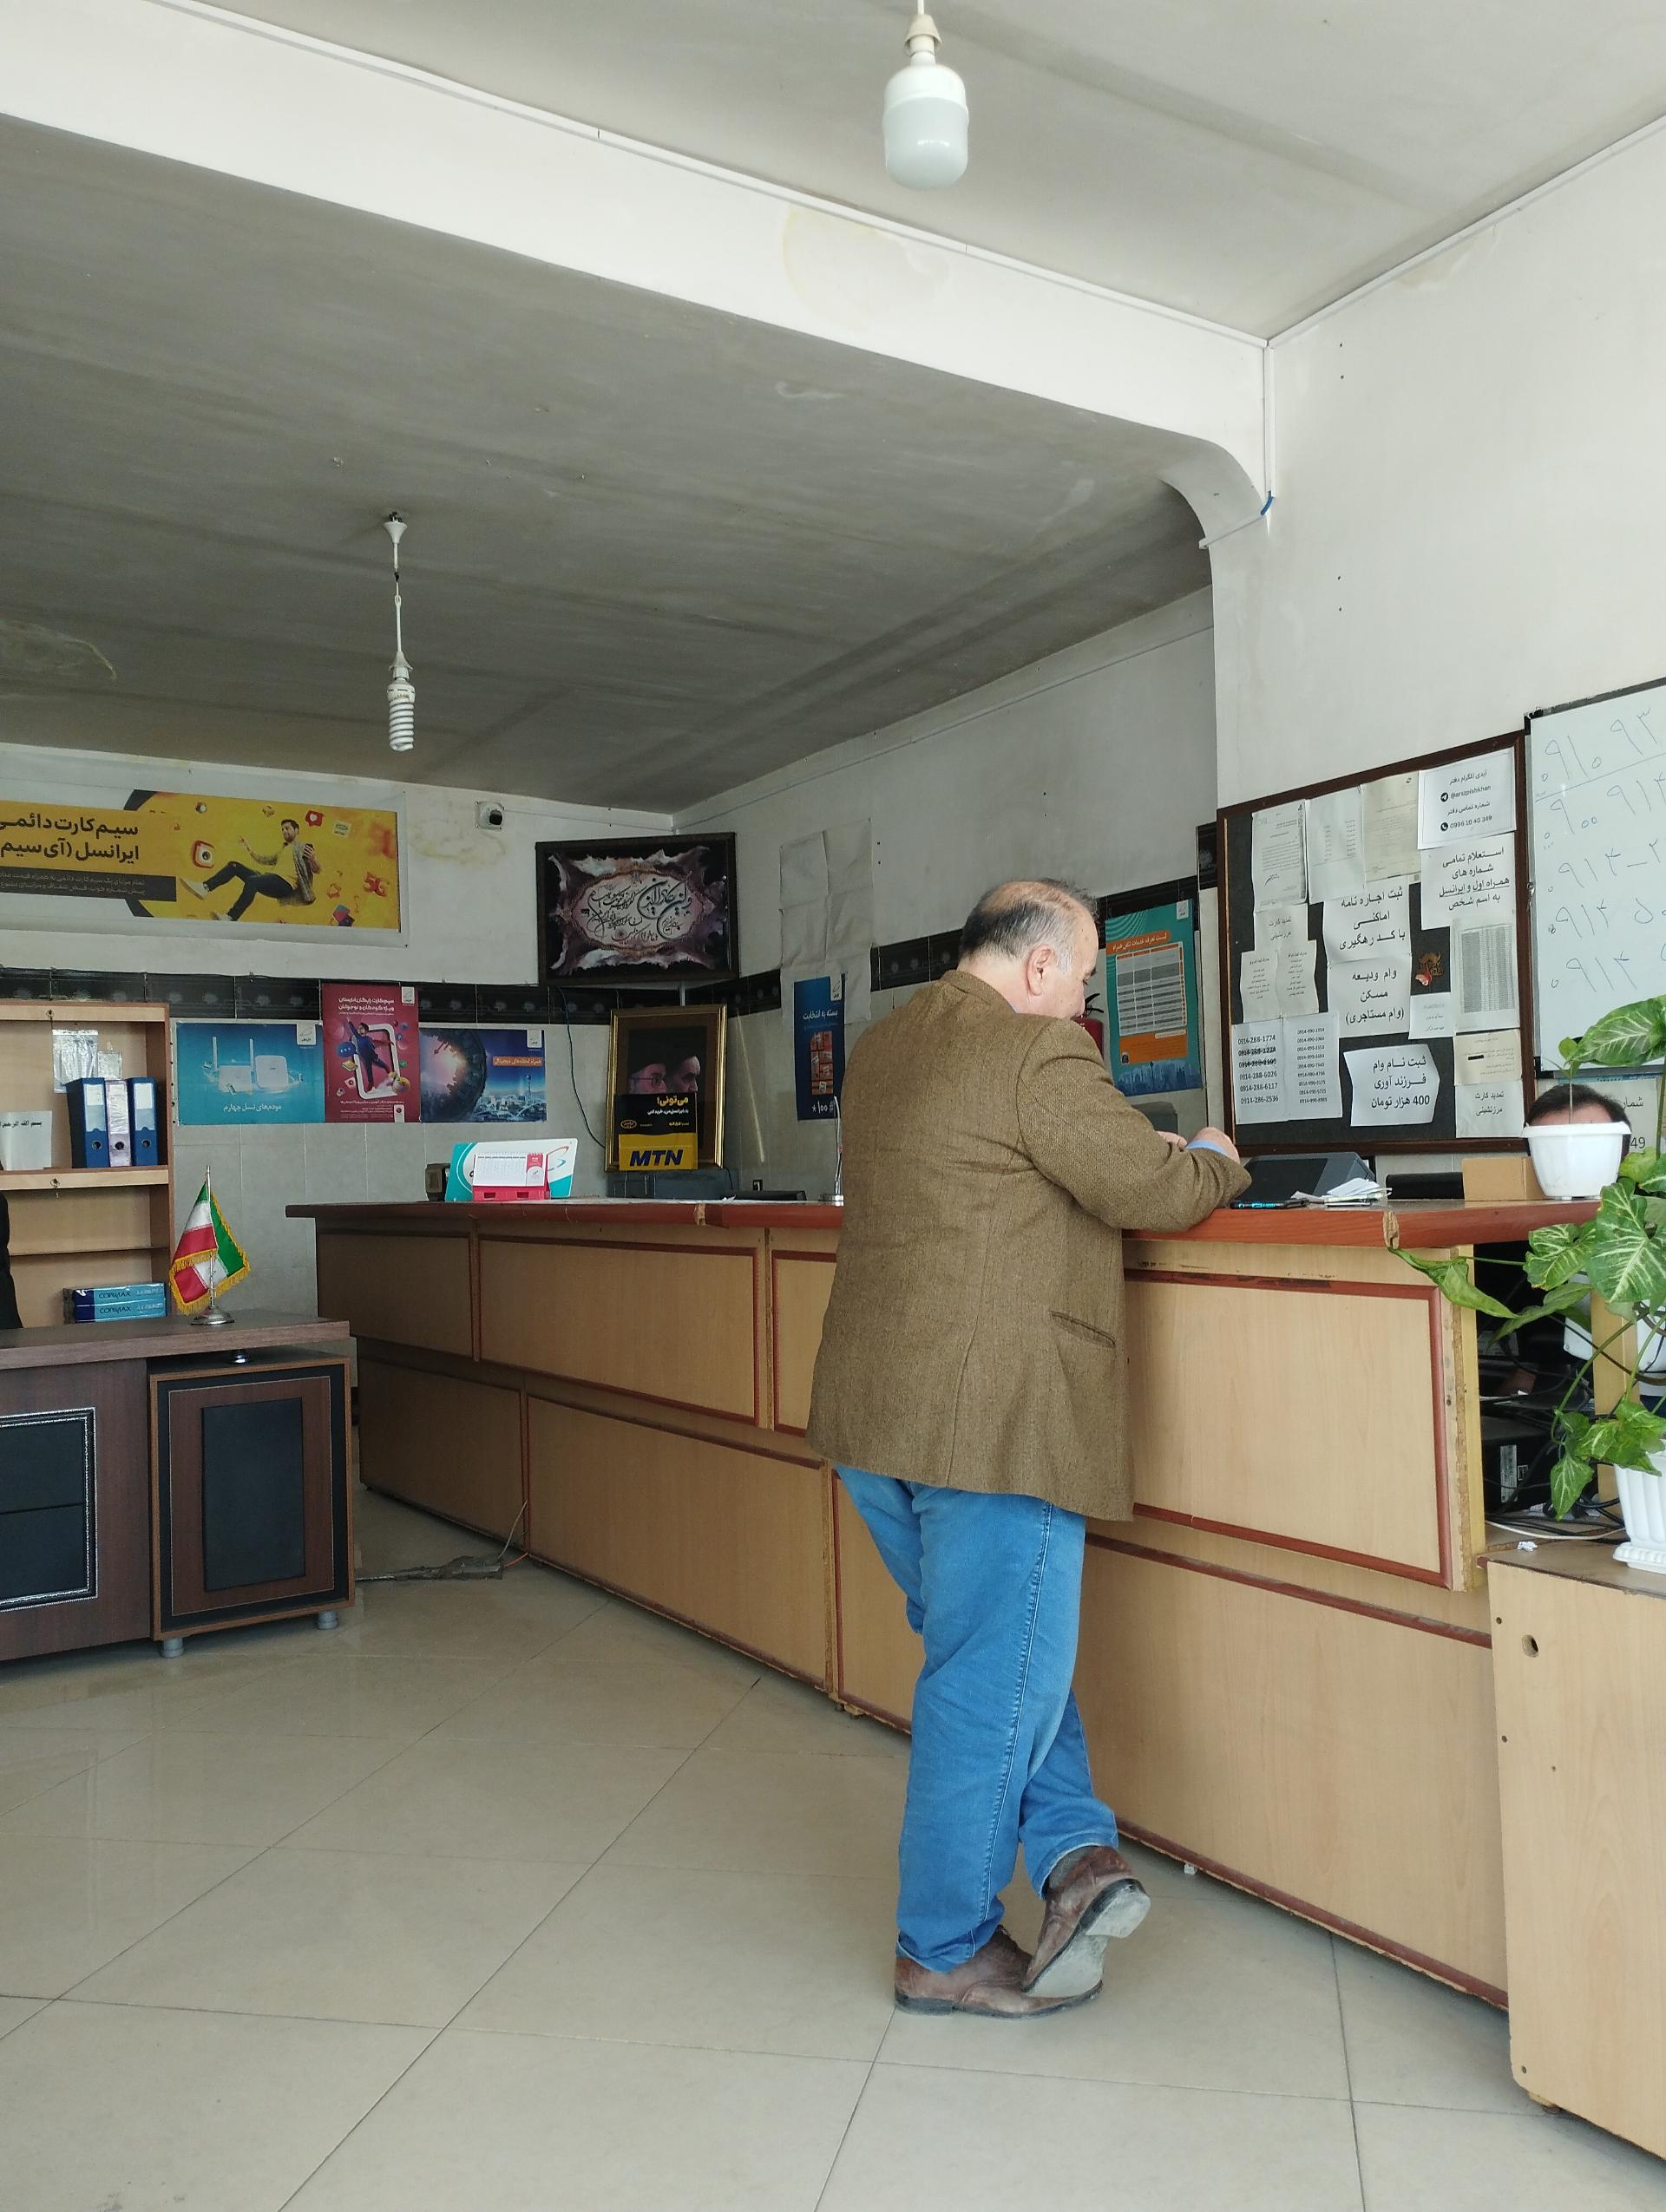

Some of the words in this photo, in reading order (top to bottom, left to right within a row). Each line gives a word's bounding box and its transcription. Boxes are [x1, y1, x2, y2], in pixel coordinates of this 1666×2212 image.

[75, 842, 139, 863] ایرانسل
[1467, 847, 1504, 865] استعلام
[1442, 854, 1466, 868] تمامی
[1453, 869, 1467, 880] های
[1469, 863, 1494, 877] شماره
[1473, 880, 1484, 891] اول
[1486, 877, 1510, 889] همراه
[1388, 886, 1402, 900] ثبت
[1440, 884, 1466, 897] ایرانسل
[1341, 896, 1357, 907] نامه
[1360, 892, 1385, 906] اجاره
[1448, 897, 1473, 911] شخص
[1476, 893, 1490, 907] اسم
[1492, 893, 1500, 903] به
[1354, 910, 1390, 930] اماکنی
[1377, 930, 1395, 941] کد
[1399, 928, 1406, 940] با
[1339, 933, 1374, 950] رهگیری
[1352, 971, 1379, 982] ودیعه
[1384, 968, 1397, 981] وام
[1360, 990, 1388, 1003] مسکن
[1373, 1059, 1384, 1074] وام
[1387, 1057, 1406, 1072] نام
[1407, 1056, 1427, 1068] ثبت
[1374, 1076, 1392, 1090] آوری
[1394, 1073, 1427, 1089] فرزند
[1371, 1096, 1393, 1109] تومان
[1394, 1096, 1410, 1109] هزار
[1413, 1095, 1430, 1105] 400
[1475, 1092, 1488, 1101] کارت
[1630, 1137, 1646, 1149] 49
[630, 1149, 683, 1167] MTN
